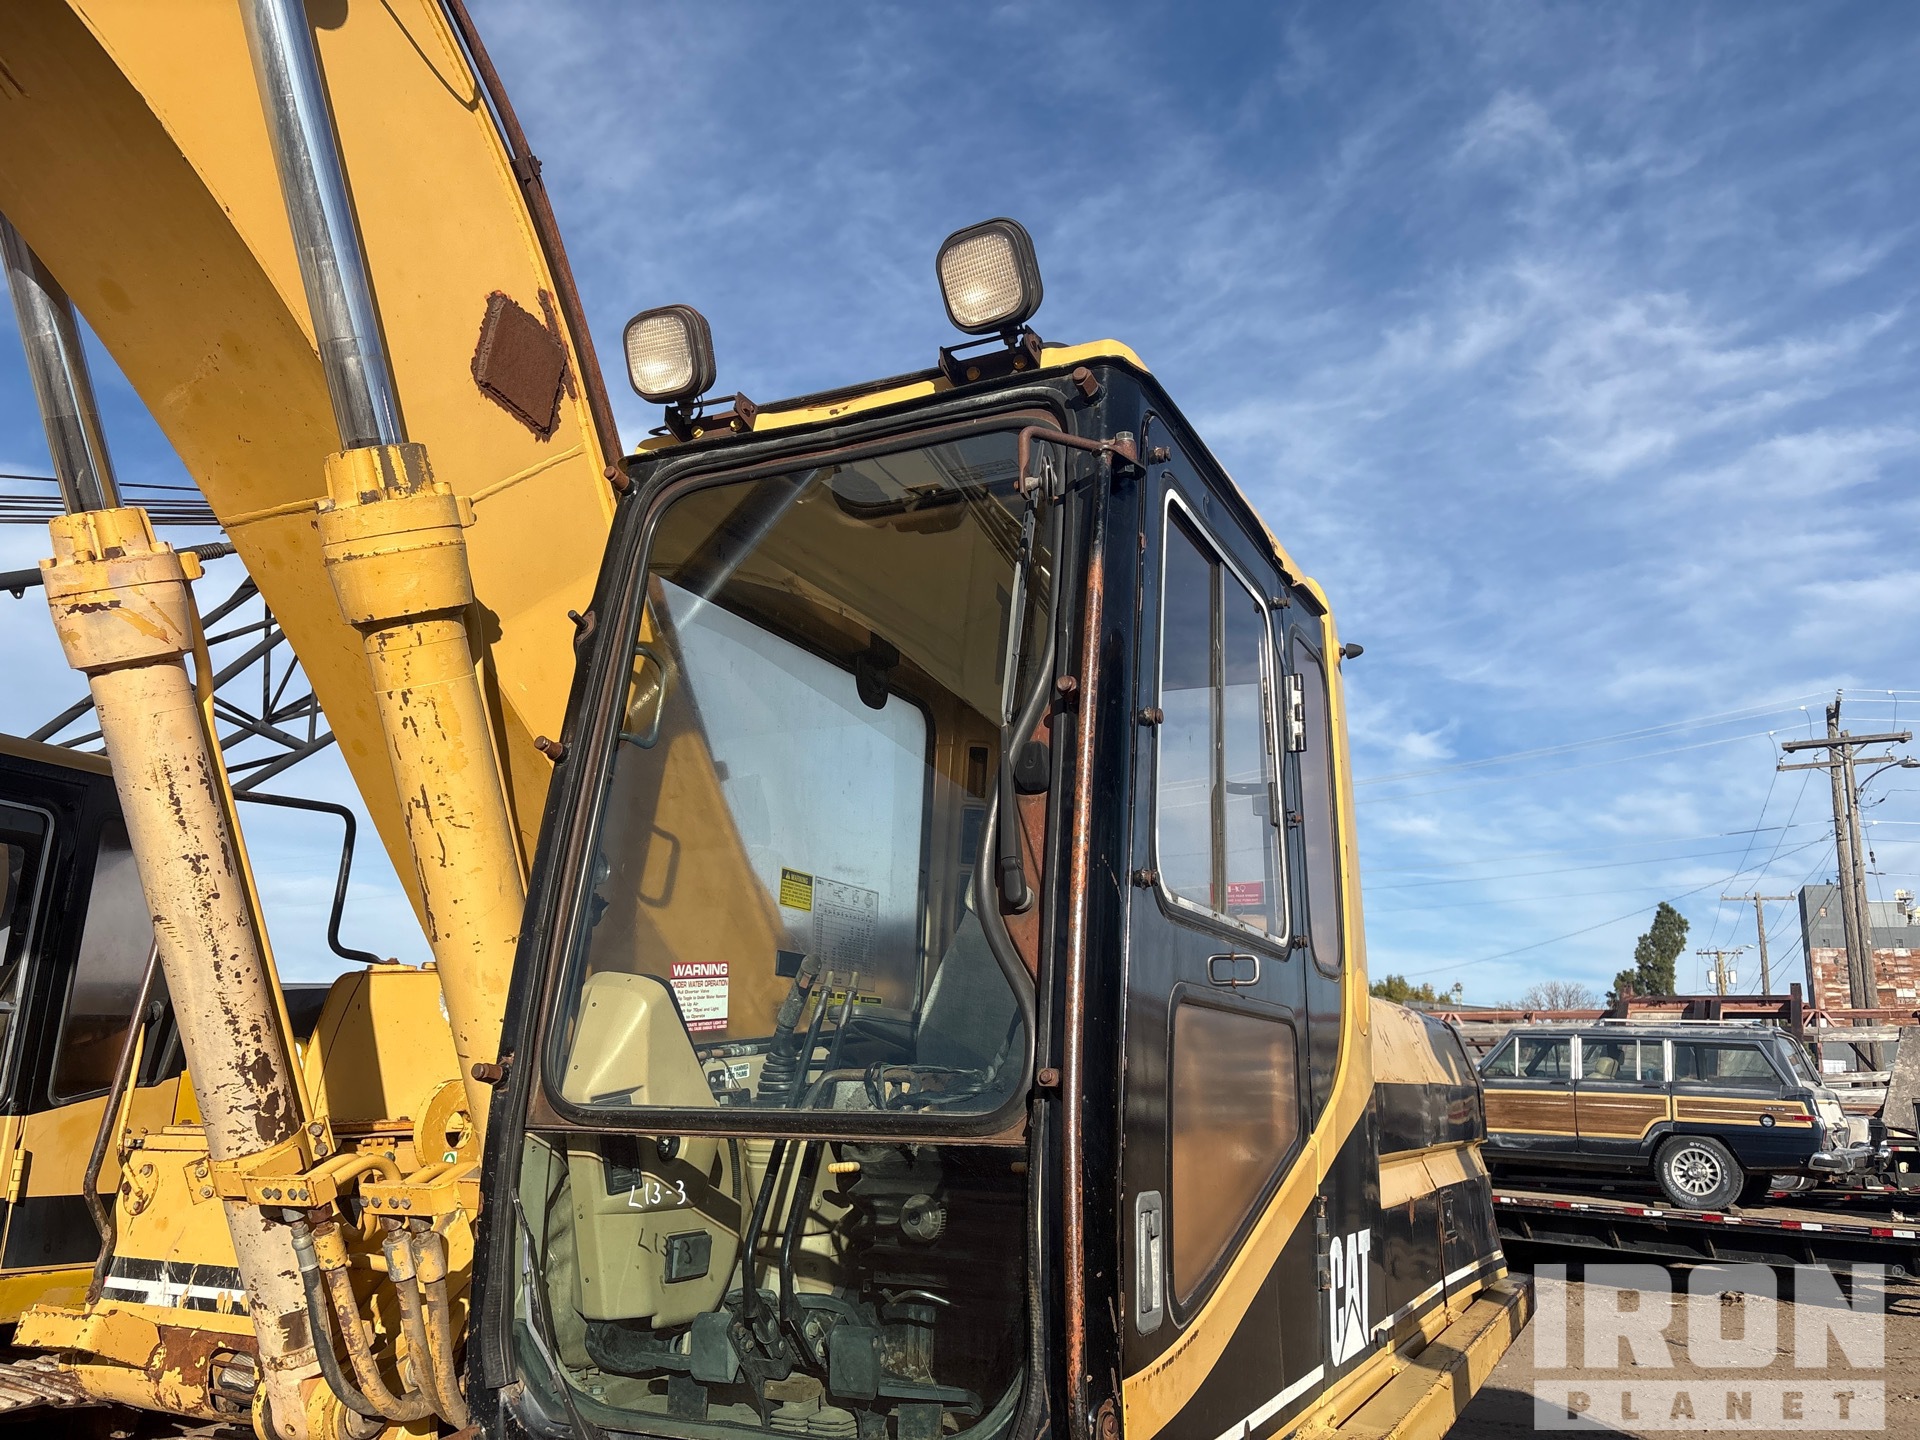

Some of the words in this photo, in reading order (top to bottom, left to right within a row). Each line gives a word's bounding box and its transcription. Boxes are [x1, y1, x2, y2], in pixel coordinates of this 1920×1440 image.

[672, 963, 728, 977] WARNING
[688, 980, 703, 988] WATER
[704, 979, 728, 987] OPERATION
[628, 1180, 686, 1209] L13-3
[637, 1227, 693, 1265] L13-3
[1329, 1228, 1371, 1367] CAT
